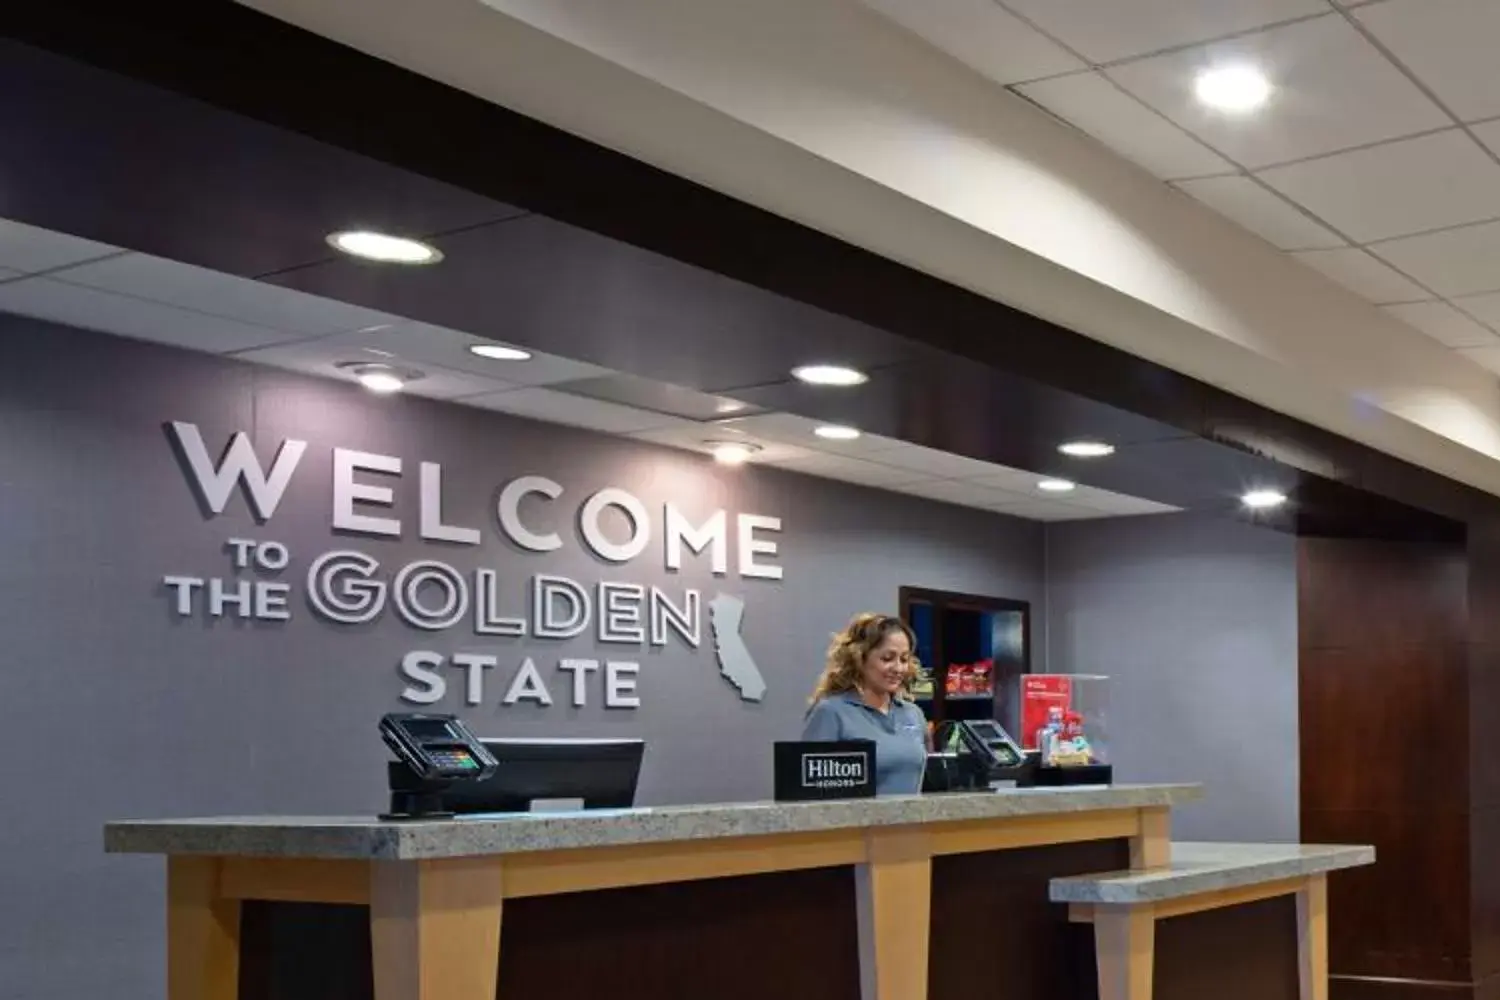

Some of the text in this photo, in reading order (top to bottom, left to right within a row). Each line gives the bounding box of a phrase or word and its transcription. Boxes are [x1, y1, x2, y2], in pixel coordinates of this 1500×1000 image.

[165, 420, 783, 578] WELCOME
[226, 537, 289, 570] TO
[163, 550, 701, 647] THE GOLDEN
[401, 649, 641, 709] STATE
[808, 759, 862, 778] Hilton
